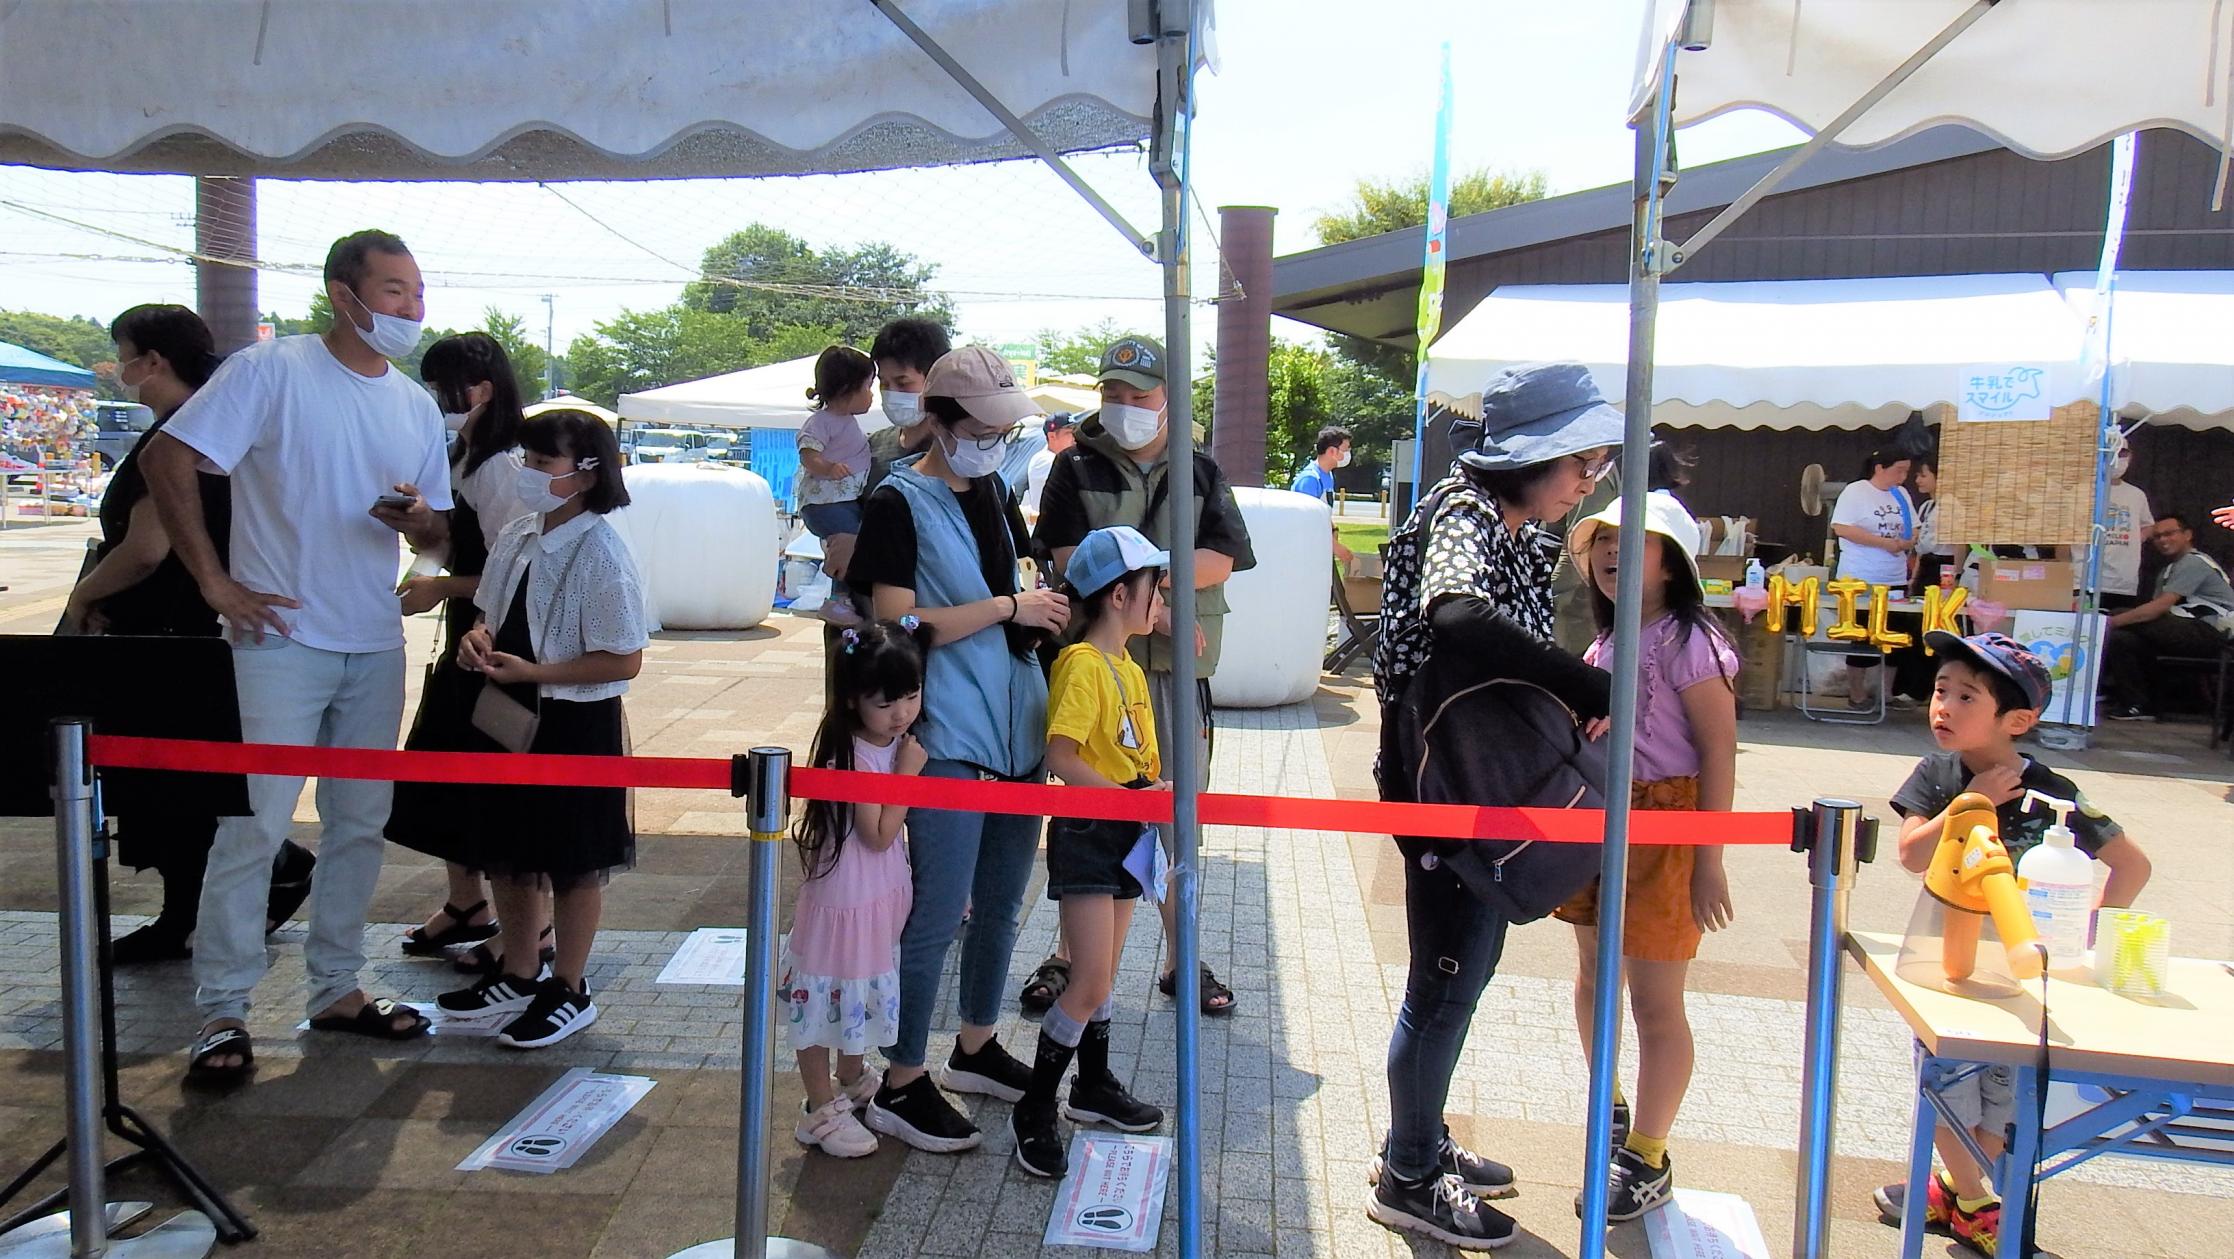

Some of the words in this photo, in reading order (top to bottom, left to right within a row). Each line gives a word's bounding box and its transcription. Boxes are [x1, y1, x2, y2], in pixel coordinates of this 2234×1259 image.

[1970, 375, 2014, 390] 牛乳で
[1966, 391, 2014, 403] スマイル
[1766, 575, 1968, 657] MILK
